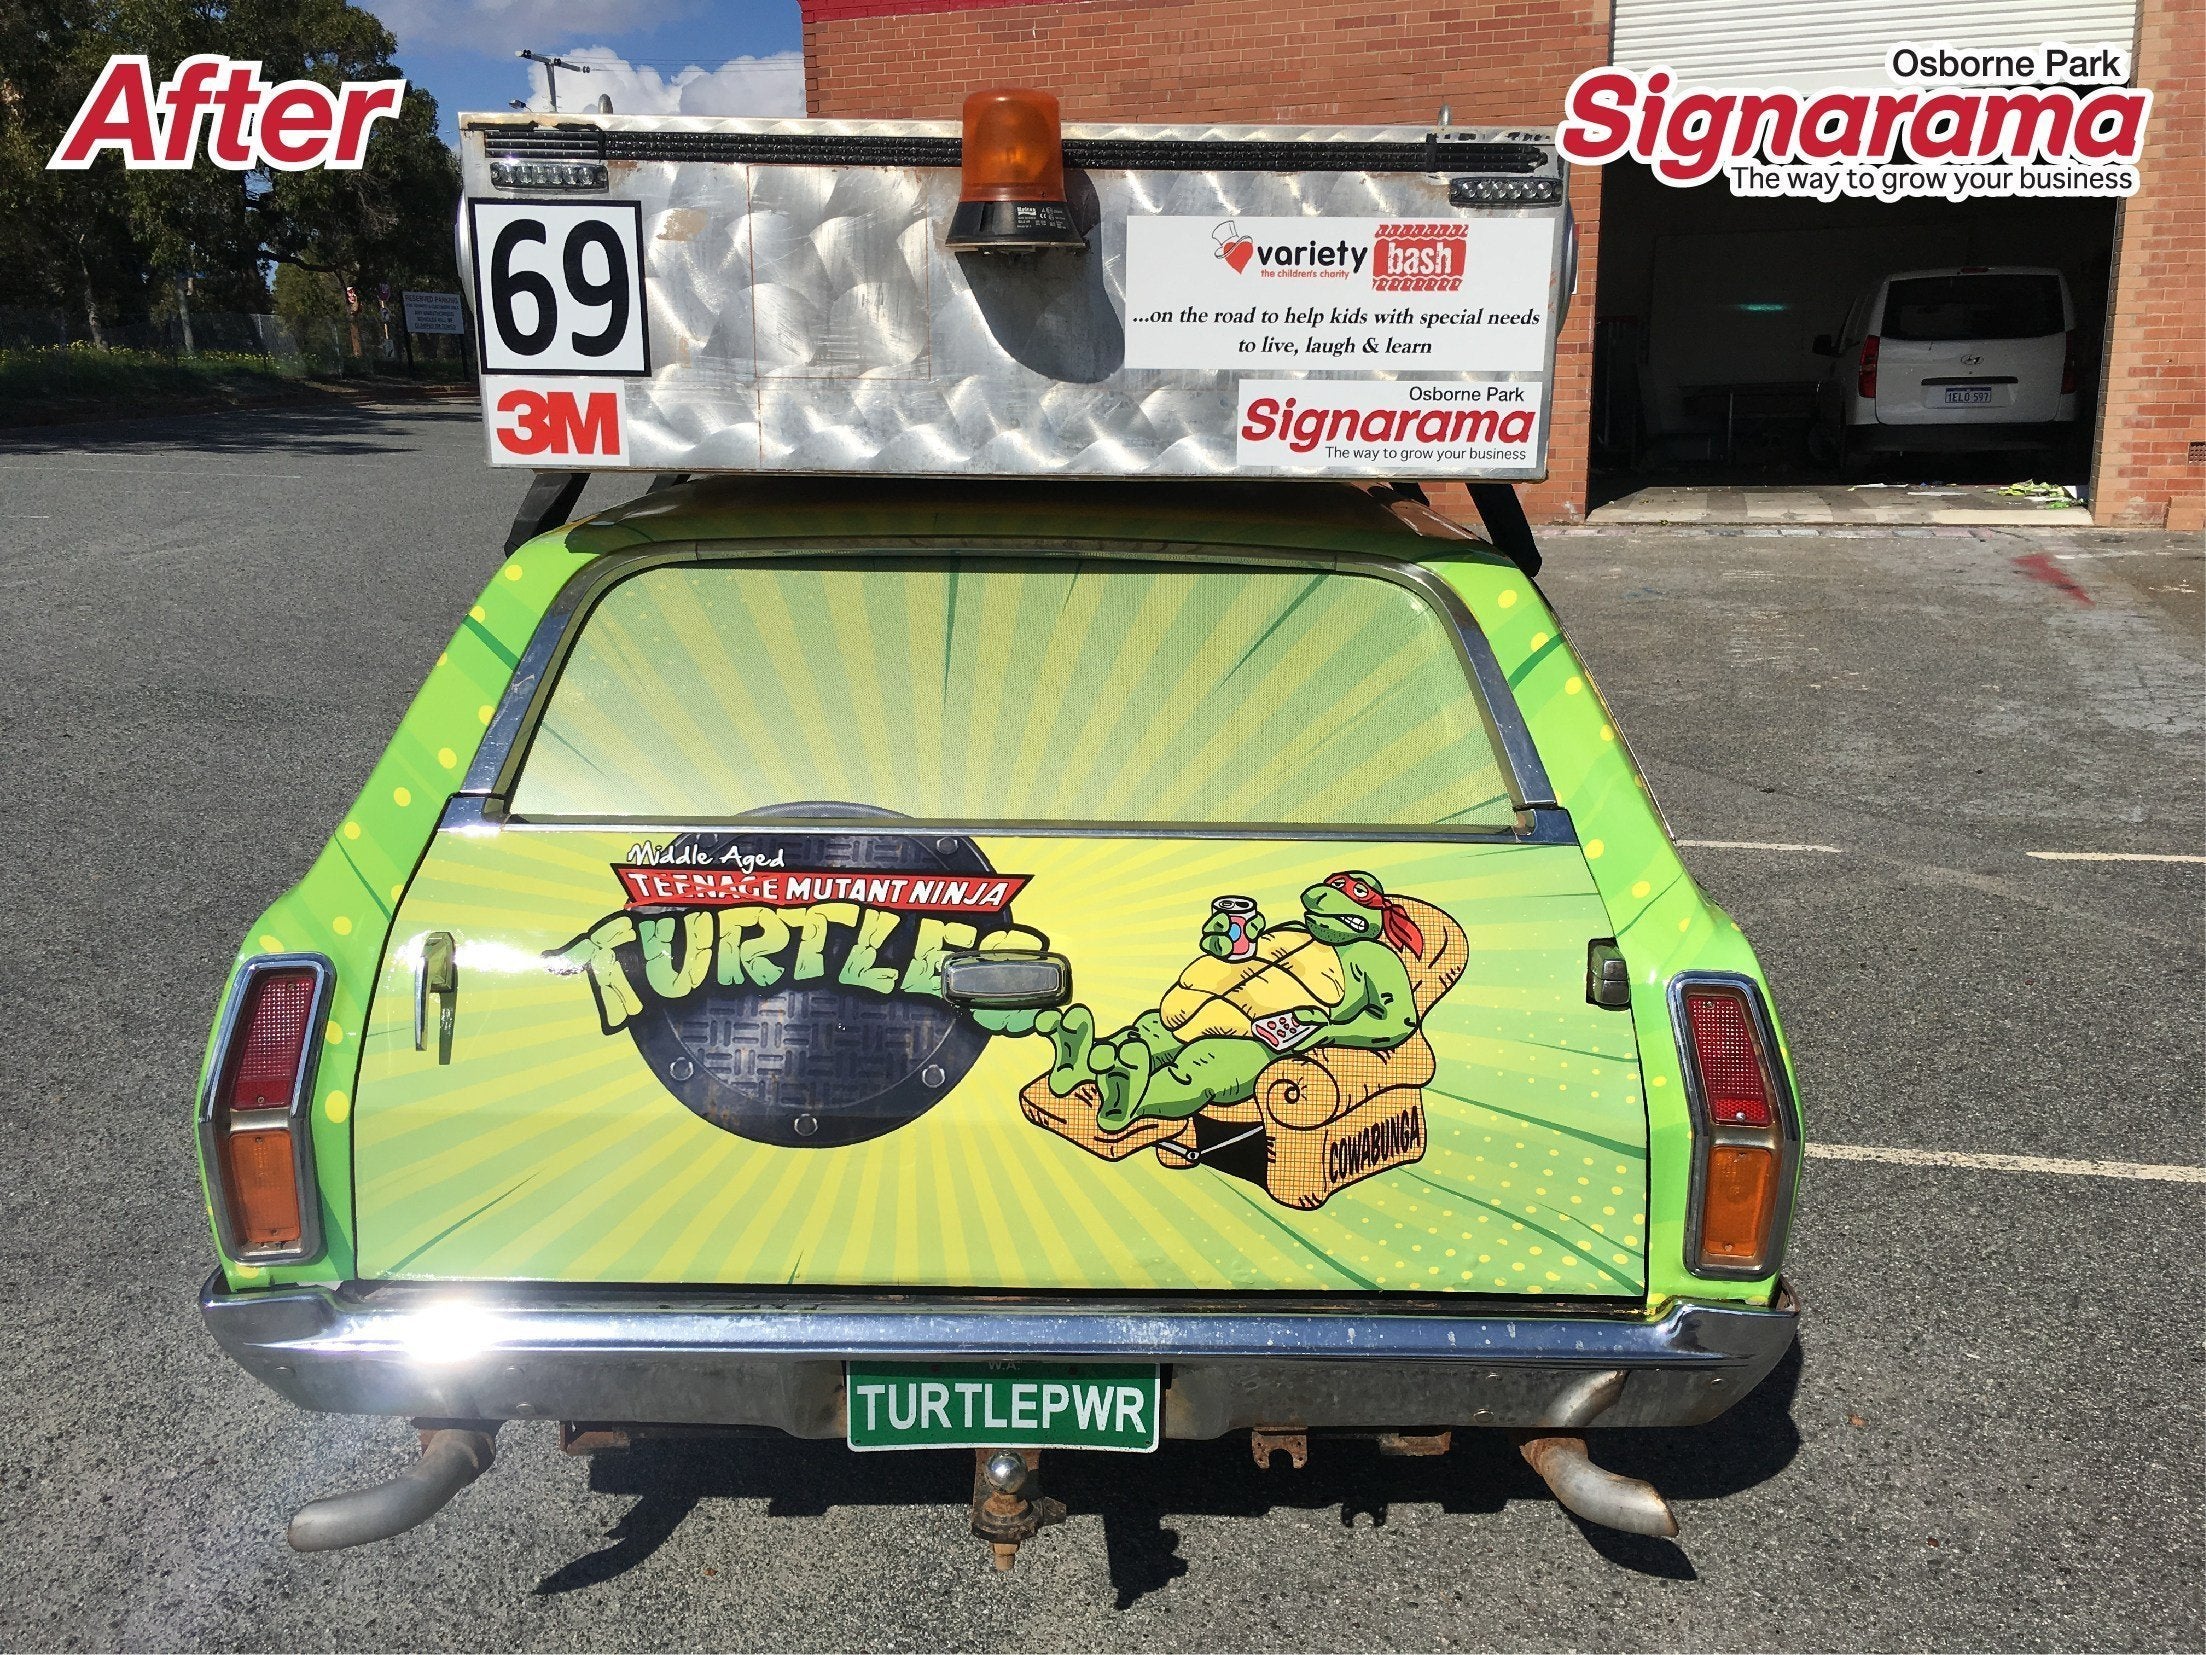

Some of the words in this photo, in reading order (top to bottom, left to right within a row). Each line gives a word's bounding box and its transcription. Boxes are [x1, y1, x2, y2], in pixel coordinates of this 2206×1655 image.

[1256, 240, 1368, 274] variety
[1387, 241, 1452, 276] bash
[1260, 269, 1275, 278] the
[1277, 269, 1317, 278] children's
[1319, 270, 1350, 280] charity
[490, 218, 630, 357] 69
[1180, 306, 1208, 323] the
[1214, 307, 1257, 323] road
[1261, 310, 1279, 324] to
[1284, 307, 1324, 328] help
[1329, 307, 1368, 324] kids
[1374, 308, 1414, 325] with
[1419, 308, 1484, 329] special
[1487, 308, 1540, 325] needs
[1238, 339, 1256, 353] to
[1261, 336, 1299, 357] live,
[1305, 336, 1355, 358] laugh
[1362, 337, 1380, 354] &
[1385, 336, 1433, 354] learn
[1408, 386, 1481, 402] Osborne
[1486, 386, 1525, 402] Park
[496, 389, 621, 456] 3M
[1241, 397, 1536, 453] Signarama
[1325, 446, 1350, 459] The
[1353, 449, 1379, 462] way
[1383, 447, 1397, 459] to
[1400, 449, 1435, 462] grow
[1436, 449, 1465, 462] your
[1469, 447, 1527, 460] business
[627, 840, 713, 866] Middle
[718, 845, 785, 875] Aged
[627, 872, 778, 900] TEENAGE
[785, 877, 908, 904] MUTANT
[908, 881, 1009, 907] NINJA
[1328, 1105, 1420, 1184] COWABUNGA
[857, 1383, 1147, 1434] TURTLEPWR
